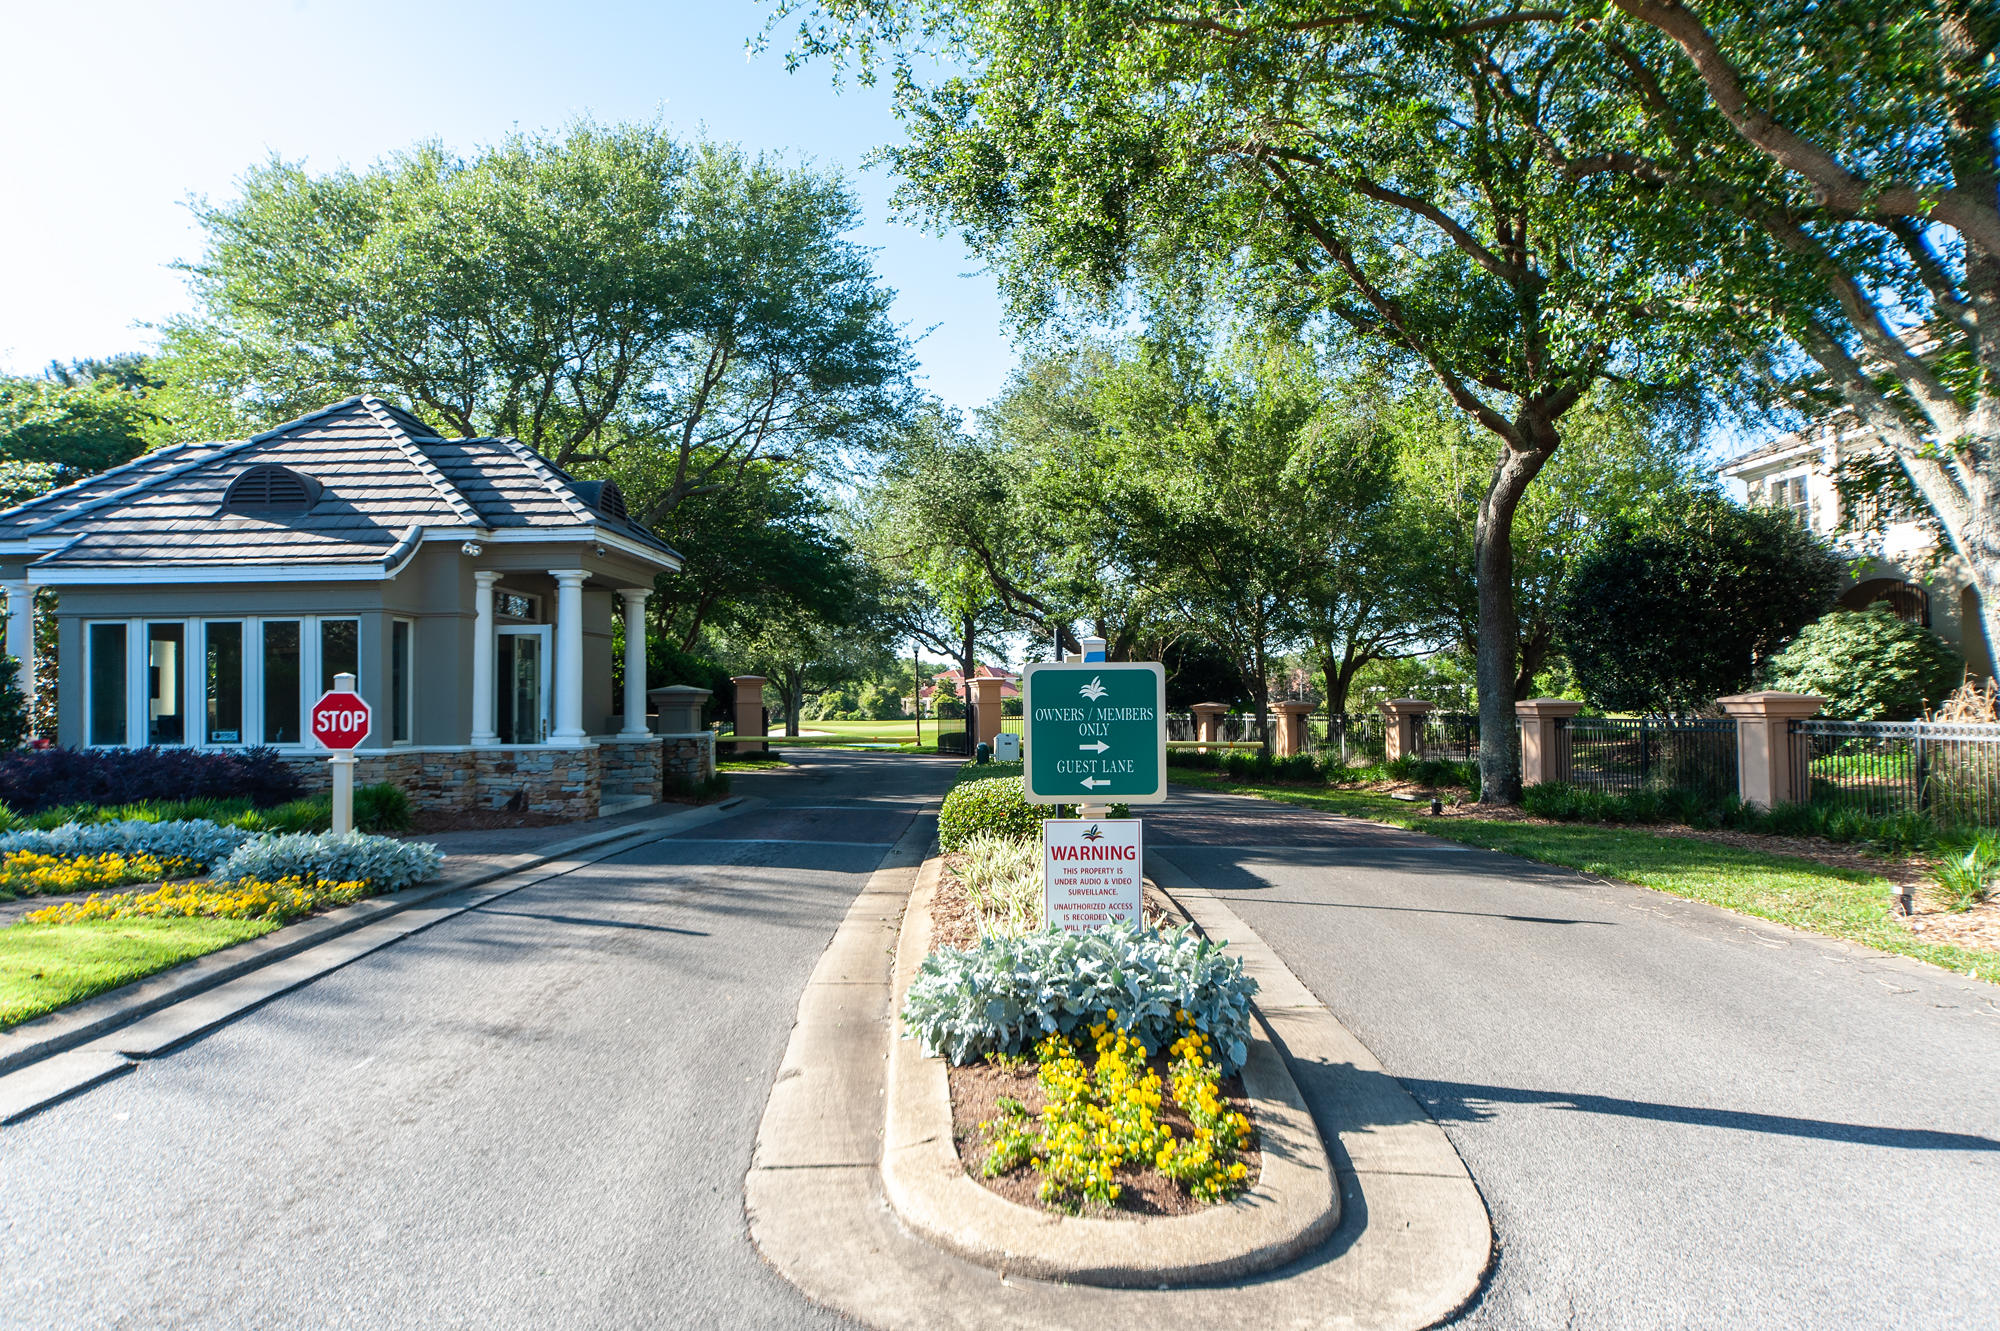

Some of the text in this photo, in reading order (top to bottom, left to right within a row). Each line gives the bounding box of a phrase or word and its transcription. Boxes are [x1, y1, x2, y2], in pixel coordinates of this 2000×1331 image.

[1035, 708, 1084, 721] OWNERS
[1097, 708, 1154, 720] MEMBERS
[317, 711, 366, 732] STOP
[1079, 723, 1109, 736] ONLY
[1057, 760, 1134, 773] GUEST LANE
[1051, 845, 1136, 861] WARNING
[1063, 867, 1123, 875] THIS PROPERTY IS
[1054, 878, 1132, 886] UNDER AUDIO & VIDEO
[1068, 888, 1119, 896] SURVEILLANCE.
[1054, 903, 1133, 911] UNAUTHORIZED ACCESS
[1072, 913, 1107, 921] RECORDED
[1109, 913, 1125, 921] ND
